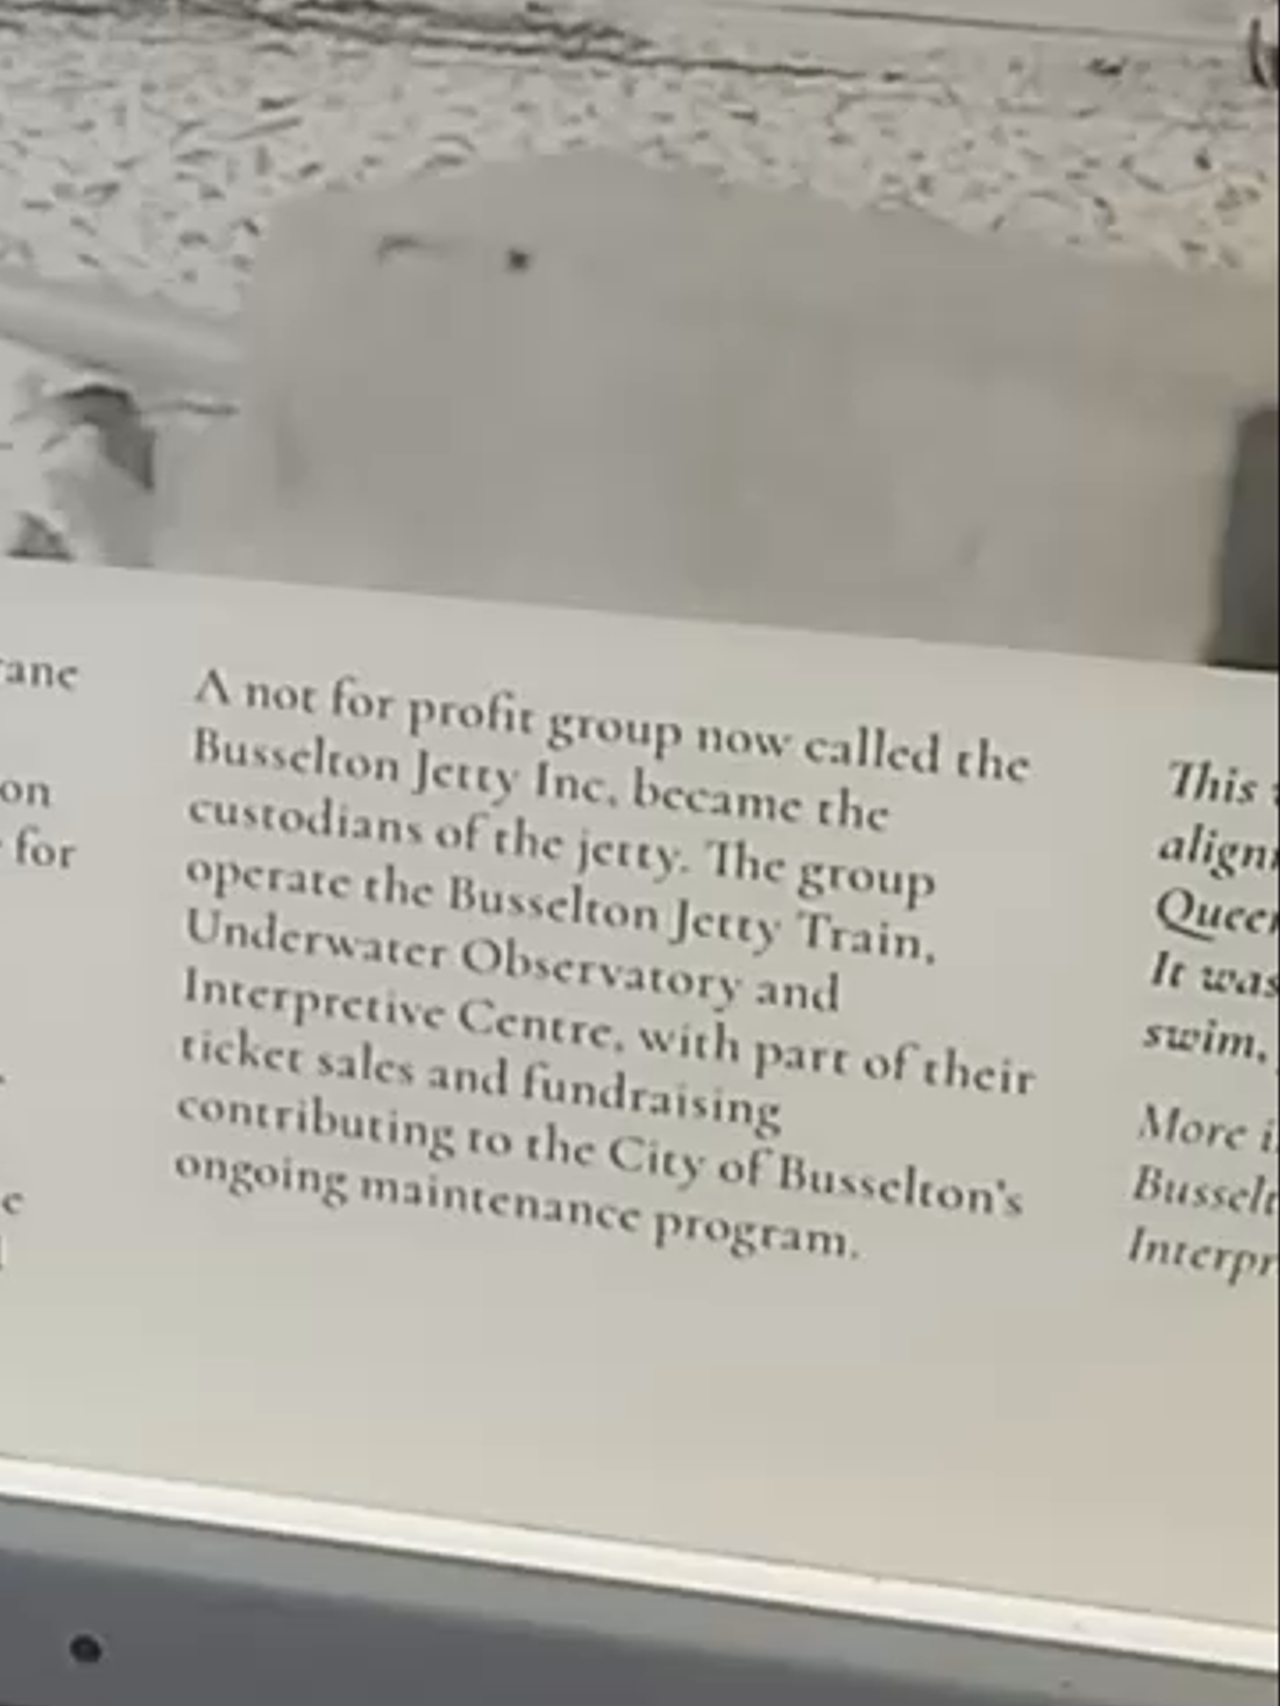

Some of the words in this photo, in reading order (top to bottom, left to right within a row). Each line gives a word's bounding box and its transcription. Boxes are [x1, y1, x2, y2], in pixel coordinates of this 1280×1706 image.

[192, 724, 401, 785] Busselton
[409, 746, 521, 809] Jetty
[632, 764, 804, 825] became
[817, 784, 891, 835] the
[193, 666, 233, 708] A
[243, 680, 318, 716] not
[330, 673, 397, 722] for
[407, 688, 536, 740] profit
[544, 712, 684, 764] group
[696, 724, 793, 759] now
[803, 723, 942, 776] called
[955, 735, 1032, 786] the
[1168, 758, 1258, 805] This
[187, 794, 425, 846] custodians
[433, 810, 486, 853] of
[493, 815, 566, 863] the
[575, 827, 690, 886] jetty.
[704, 837, 787, 886] The
[795, 861, 938, 914] group
[184, 858, 354, 902] operate
[363, 861, 436, 910] the
[447, 873, 660, 934] Busselton
[666, 896, 783, 959] Jetty
[795, 908, 937, 967] Train,
[186, 905, 449, 971] Underwater
[460, 935, 744, 1016] Observatory
[754, 970, 840, 1015] and
[1151, 949, 1188, 989] It
[180, 1025, 303, 1076] ticket
[316, 1038, 416, 1086] sales
[427, 1054, 510, 1098] and
[521, 1058, 783, 1142] fundraising
[183, 964, 448, 1032] Interpretive
[457, 997, 626, 1055] Centre,
[637, 1019, 741, 1065] with
[753, 1039, 850, 1082] part
[862, 1040, 918, 1083] of
[921, 1048, 1038, 1099] their
[176, 1093, 458, 1165] contributing
[467, 1126, 515, 1159] to
[525, 1120, 597, 1169] the
[607, 1134, 707, 1193] City
[717, 1144, 775, 1188] of
[778, 1155, 1024, 1219] Busselton's
[1137, 1101, 1248, 1151] More
[173, 1153, 351, 1212] ongoing
[359, 1172, 643, 1234] maintenance
[653, 1210, 860, 1261] program.
